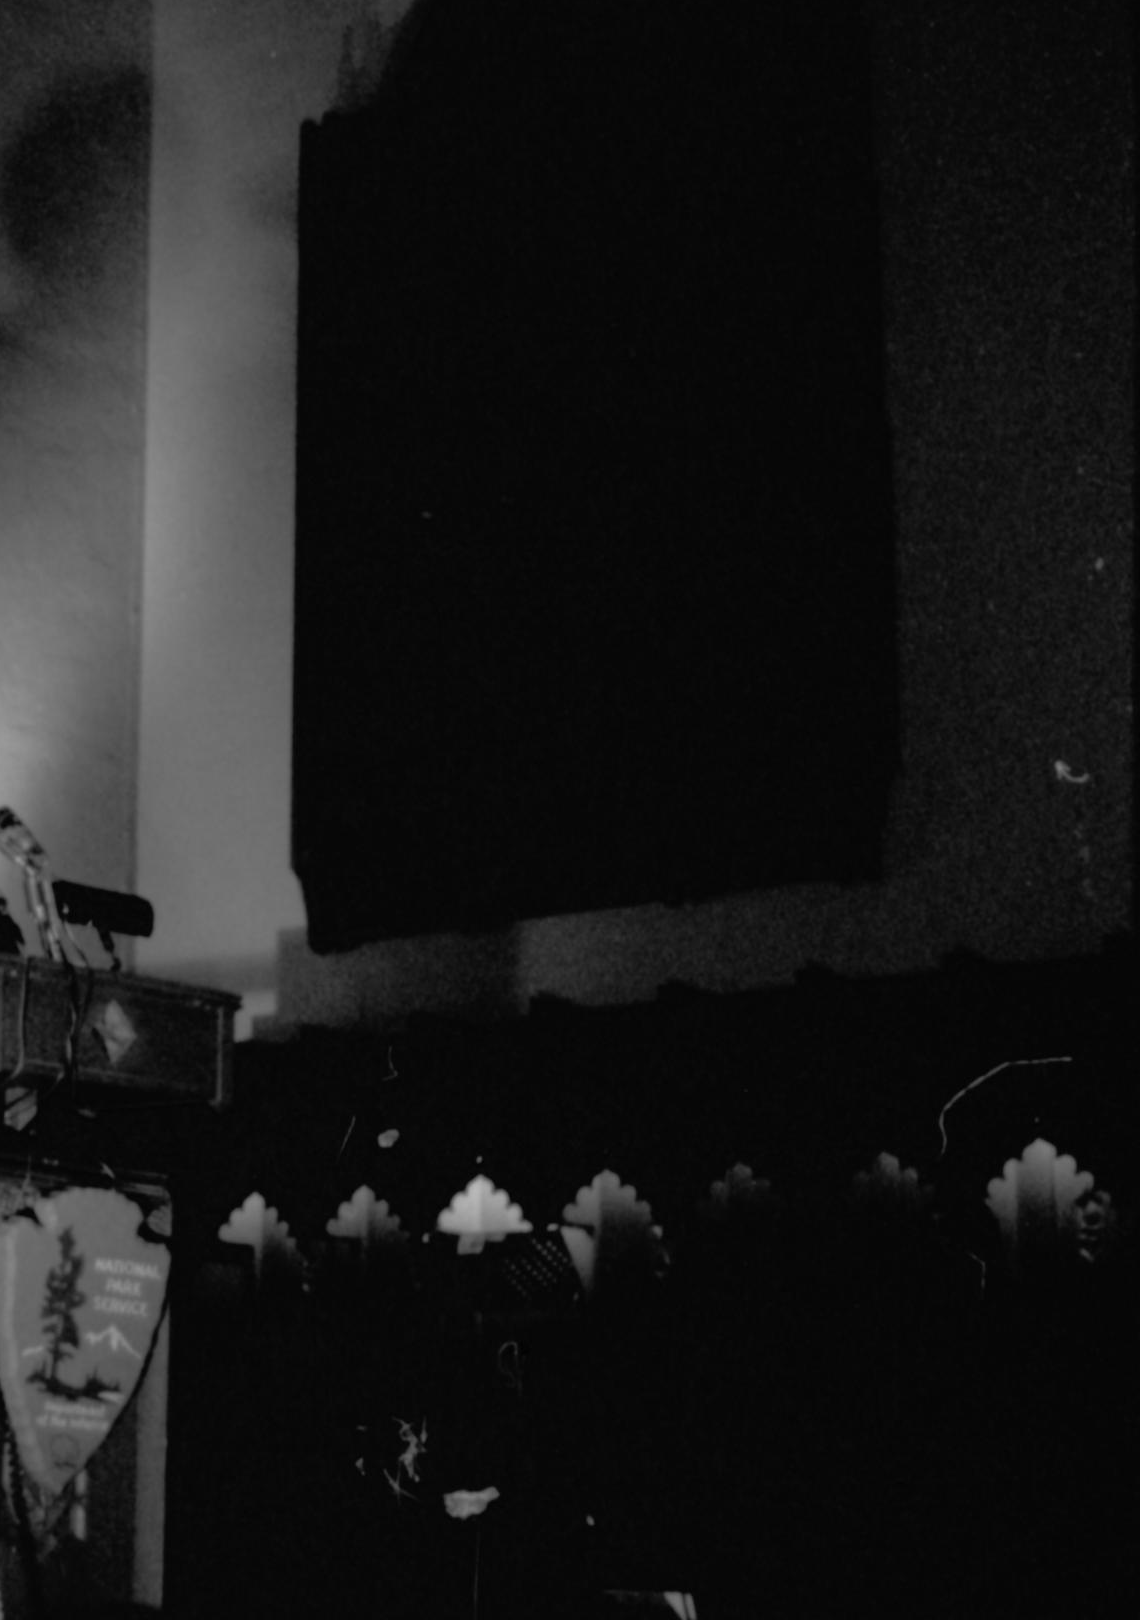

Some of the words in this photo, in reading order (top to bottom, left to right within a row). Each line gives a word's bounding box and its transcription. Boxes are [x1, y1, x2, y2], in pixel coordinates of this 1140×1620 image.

[95, 1258, 161, 1278] NATIONAL
[106, 1277, 142, 1296] PARK
[93, 1295, 148, 1316] SERVICE
